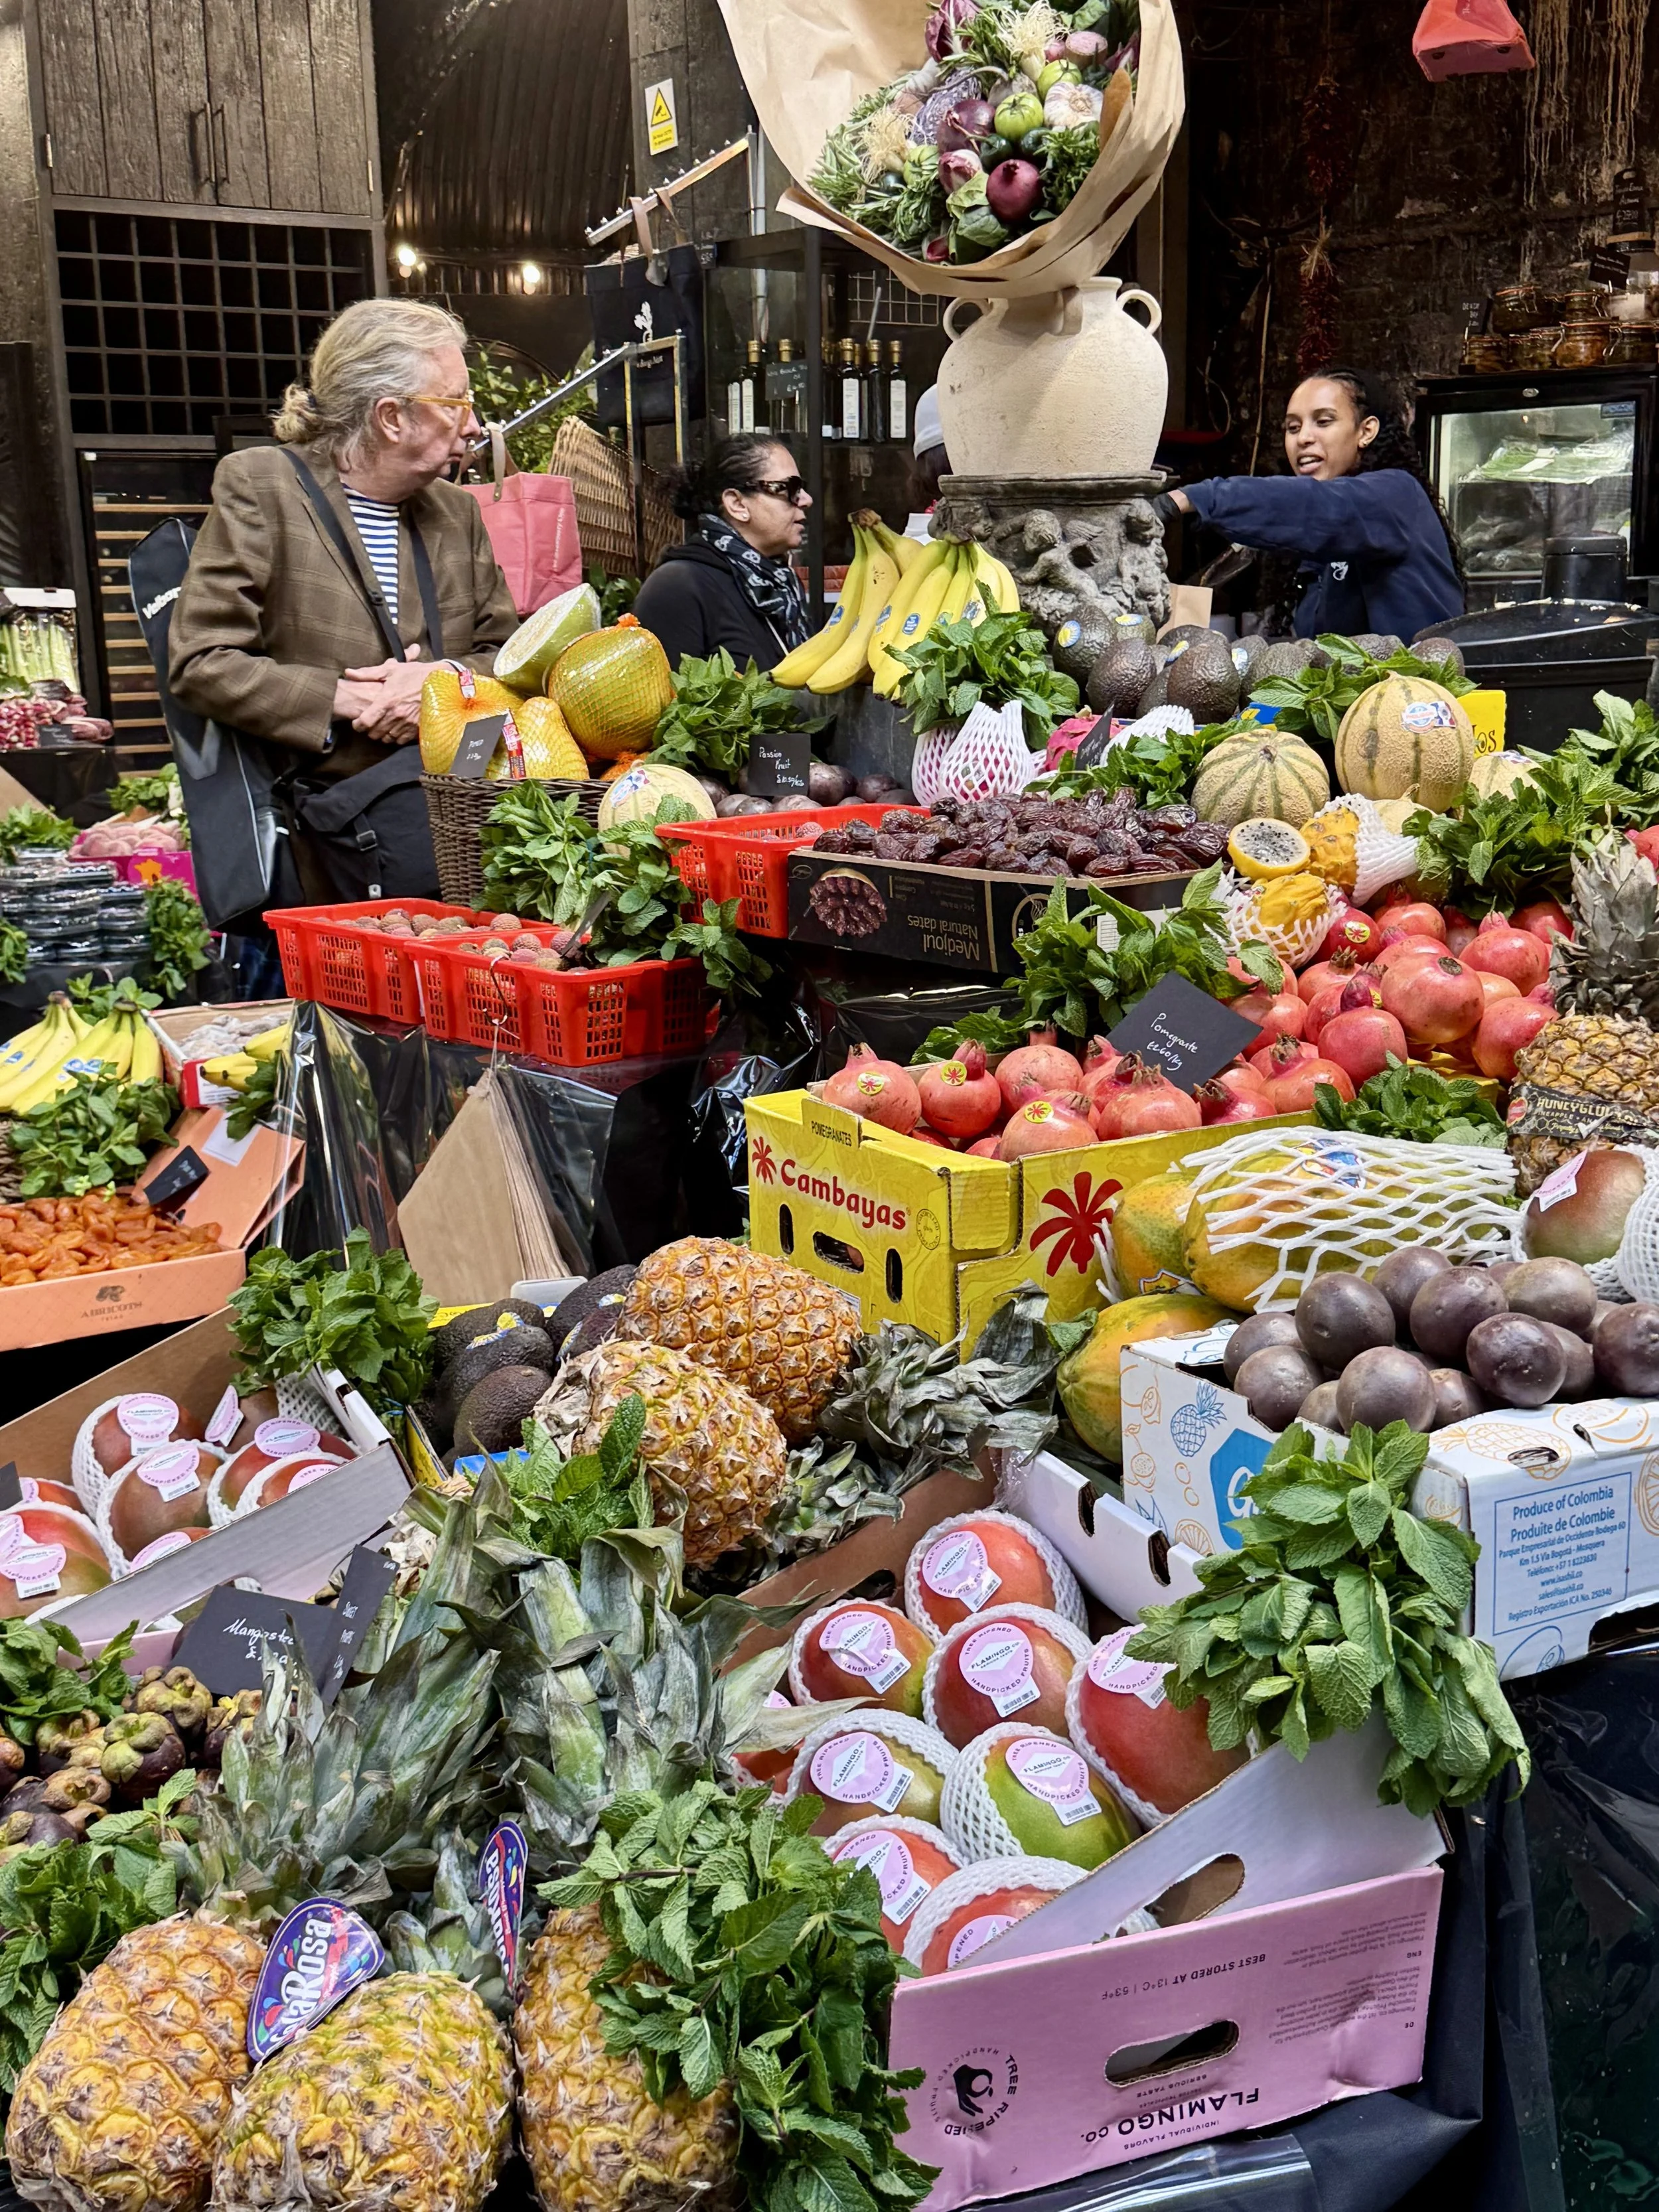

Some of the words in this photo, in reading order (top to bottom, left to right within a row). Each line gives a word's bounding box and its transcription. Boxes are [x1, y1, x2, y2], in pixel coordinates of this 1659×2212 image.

[759, 747, 782, 758] Passion
[908, 915, 937, 932] dates
[940, 920, 978, 940] Natural
[923, 934, 979, 961] Medjoul
[812, 1120, 852, 1147] POMEGRANATES
[781, 1158, 906, 1230] Cambayas
[1514, 1501, 1553, 1520] Produce
[1555, 1495, 1565, 1511] of
[1567, 1486, 1614, 1507] Colombia
[1555, 1518, 1567, 1532] de
[1569, 1507, 1615, 1528] Colombie
[934, 1547, 964, 1579] FLAMINGO
[1499, 1547, 1520, 1559] Parque
[1520, 1558, 1529, 1566] Km
[938, 1572, 981, 1594] HANPICED
[882, 1623, 891, 1651] FRUITS
[965, 1639, 977, 1655] TREE
[979, 1627, 1012, 1638] RIPENED
[971, 1645, 1011, 1669] FLAMINGO
[1103, 1655, 1125, 1677] FLAMI
[971, 1678, 1021, 1693] HANDPICKED
[1021, 1648, 1030, 1677] FRUITS
[1108, 1665, 1158, 1690] HANDPICKED
[819, 1737, 849, 1760] RIPENED
[833, 1748, 859, 1787] FLAMINGO
[842, 1771, 889, 1800] HANDPICKED
[873, 1740, 889, 1767] FRUITS
[1023, 1757, 1062, 1773] FLAMINGO
[1027, 1783, 1080, 1800] HANDPICKED
[843, 1834, 877, 1857] RIPENED
[897, 1845, 908, 1876] FRUITS
[1191, 1961, 1235, 1980] STORED
[1238, 1954, 1265, 1968] BEST
[1143, 1978, 1167, 1991] 13°C
[1173, 1974, 1187, 1984] AT
[938, 2047, 999, 2081] HANDPICKED
[1005, 2055, 1019, 2095] TREE
[1137, 2087, 1165, 2098] TASTE
[1169, 2073, 1207, 2089] SERIOUS
[930, 2087, 940, 2122] FRUITS
[1118, 2087, 1259, 2135] FLAMINGO
[1081, 2126, 1109, 2142] CO.
[1169, 2119, 1220, 2137] INDIVIDUAL
[1123, 2134, 1165, 2150] FLAVORS
